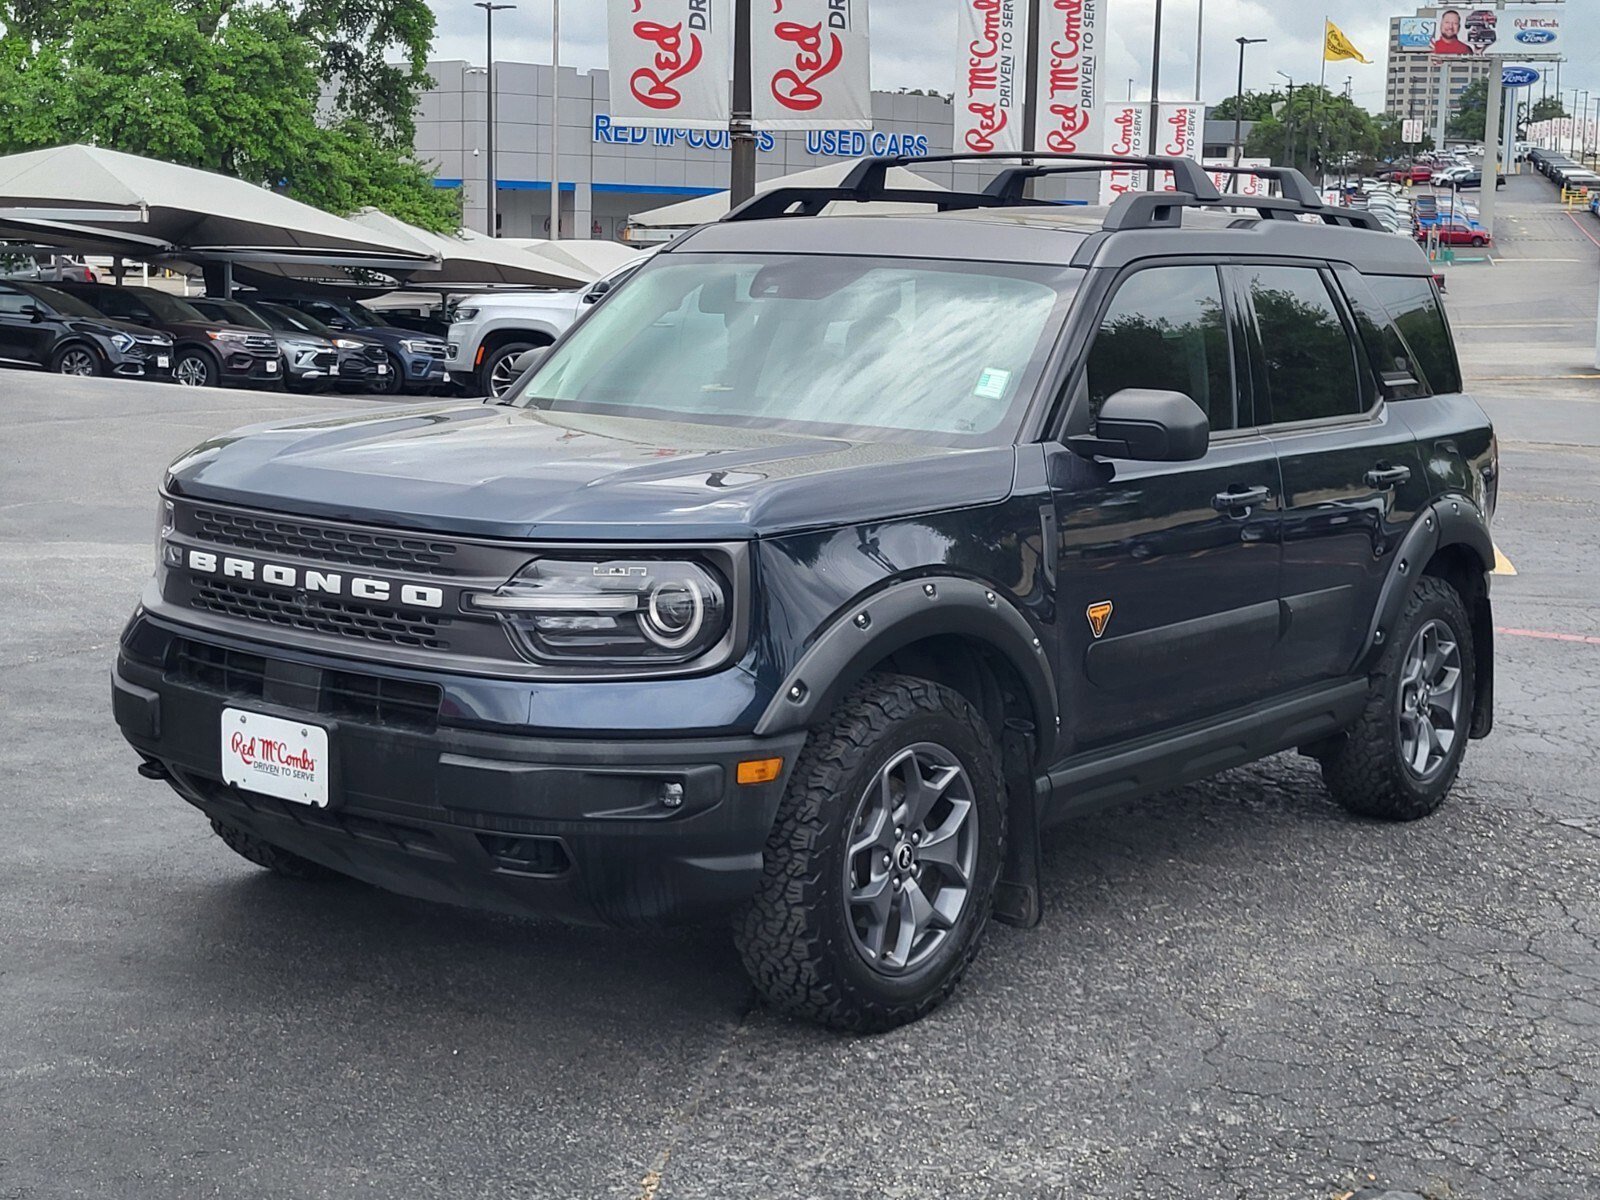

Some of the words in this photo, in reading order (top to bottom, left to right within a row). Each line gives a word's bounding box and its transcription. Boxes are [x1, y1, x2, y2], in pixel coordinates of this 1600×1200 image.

[1002, 0, 1014, 28] SER
[1083, 0, 1095, 28] SER
[1001, 32, 1013, 51] TO
[1083, 33, 1094, 51] TO
[1522, 32, 1549, 42] Ford
[630, 20, 702, 109] Red
[771, 21, 843, 111] Red
[1000, 55, 1012, 108] DRIVEN
[1081, 56, 1093, 108] DRIVEN
[593, 114, 648, 144] RED
[807, 130, 866, 156] USED
[871, 132, 929, 157] CARS
[965, 102, 1007, 152] Red
[1047, 103, 1089, 153] Red
[1133, 108, 1143, 137] SERVE
[1186, 108, 1197, 137] SERVE
[1132, 139, 1141, 152] TO
[1186, 139, 1195, 152] TO
[188, 550, 443, 608] BRONCO
[231, 731, 256, 765] Red
[258, 737, 315, 772] McCombs
[253, 760, 280, 774] DRIVEN
[281, 766, 292, 777] TO
[293, 769, 315, 782] SERVE
